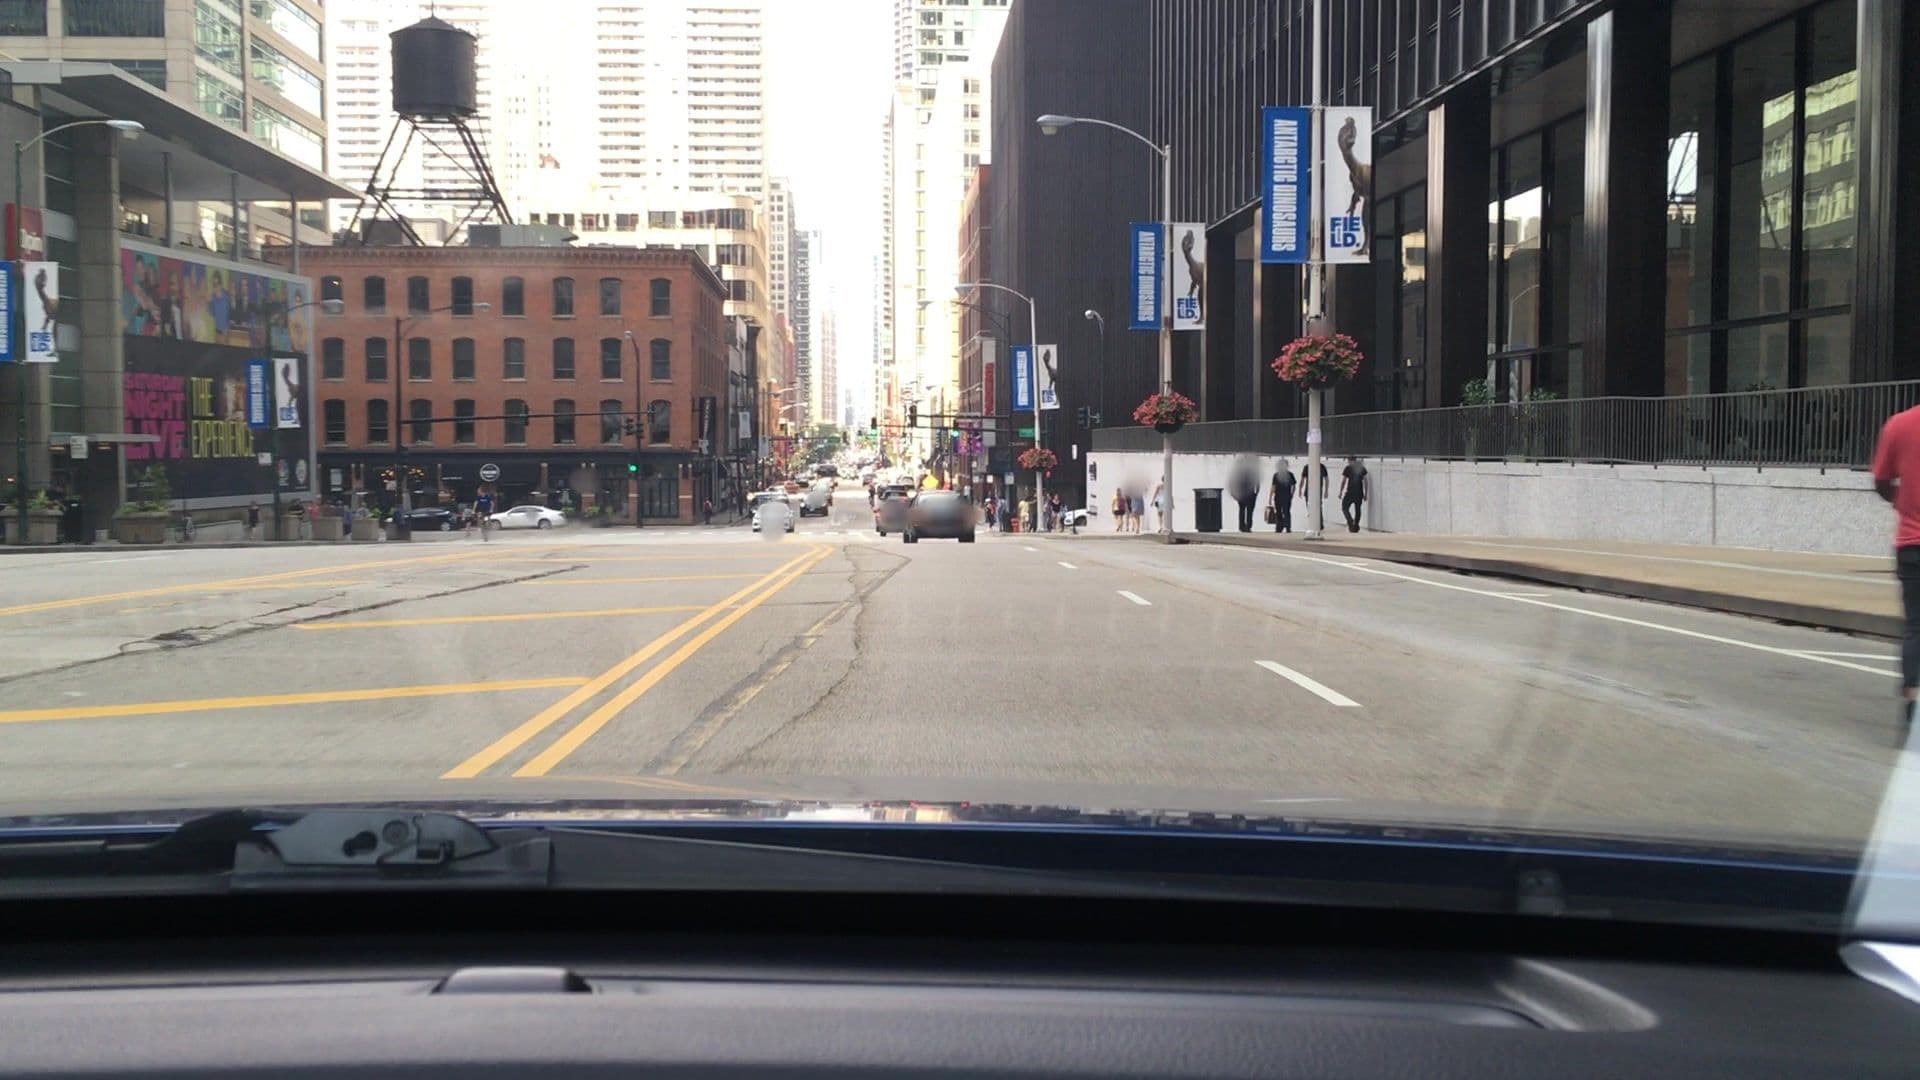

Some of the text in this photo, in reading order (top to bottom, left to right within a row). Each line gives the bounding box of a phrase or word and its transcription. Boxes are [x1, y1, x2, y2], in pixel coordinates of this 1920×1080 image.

[1272, 119, 1298, 252] ANTARCTIC DINOSAURS
[1330, 217, 1360, 231] FIE
